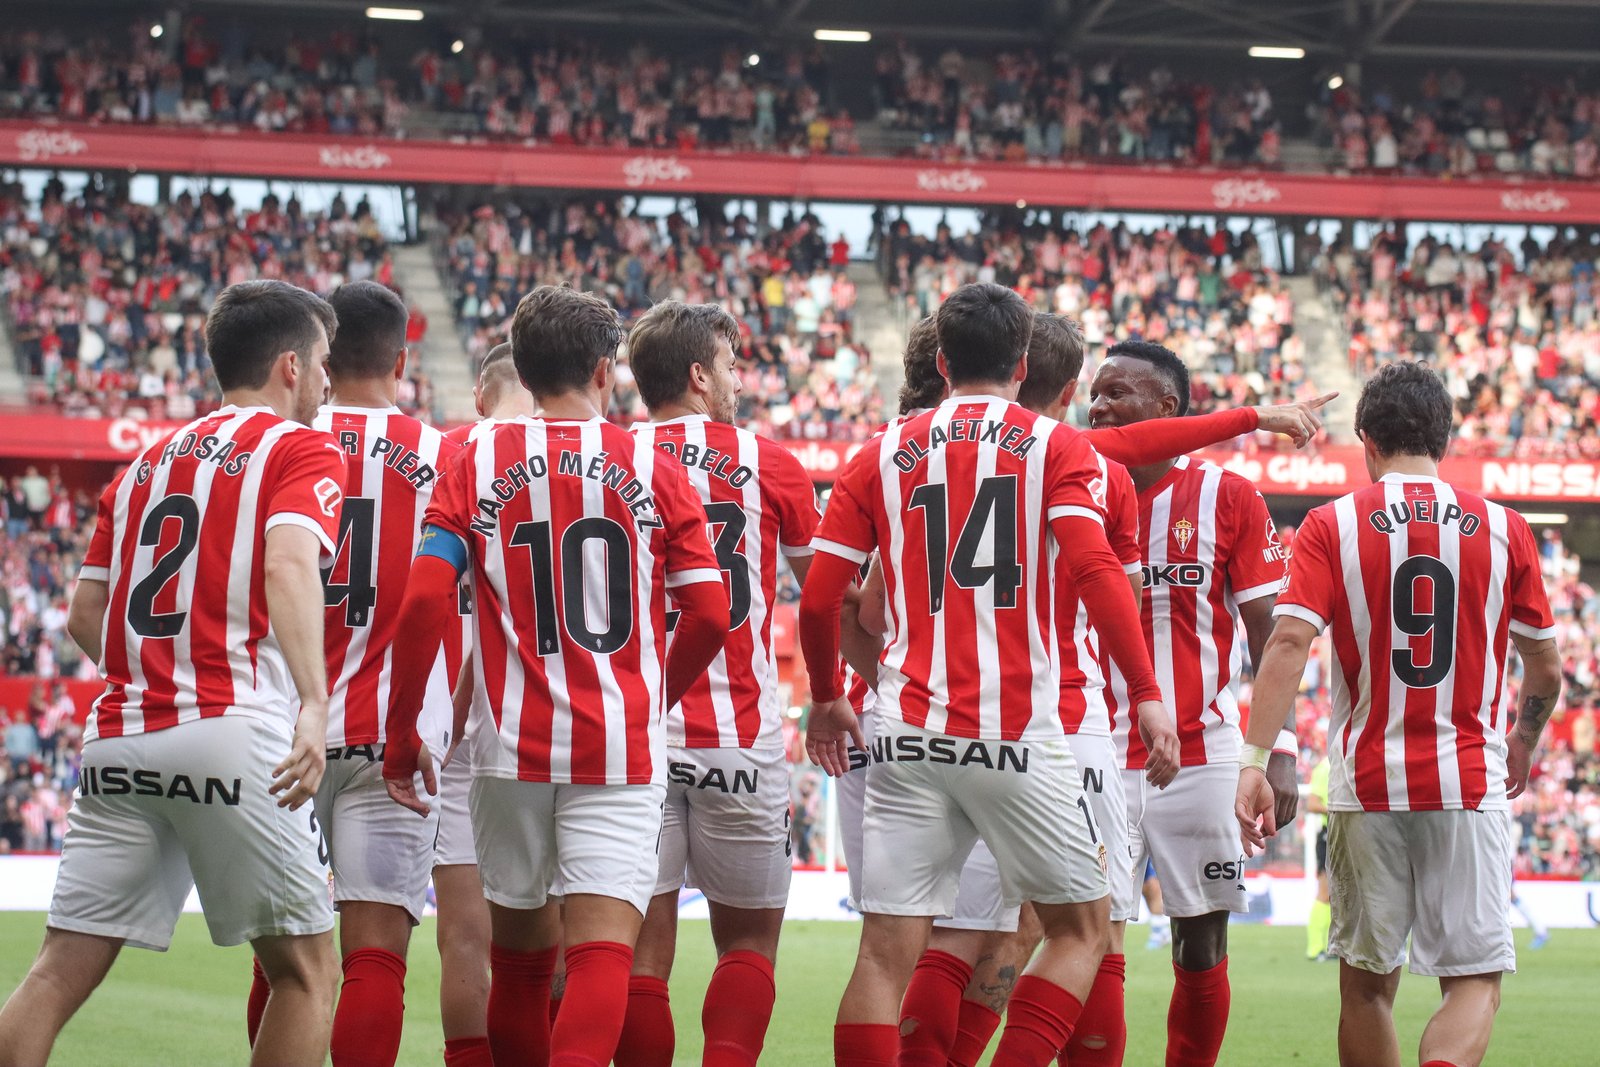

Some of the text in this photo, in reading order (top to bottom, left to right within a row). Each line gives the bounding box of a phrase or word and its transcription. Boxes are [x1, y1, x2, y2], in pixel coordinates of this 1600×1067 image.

[160, 432, 252, 476] ROSAS
[369, 436, 436, 490] PIER
[891, 418, 1038, 473] OLAETXEA
[469, 450, 664, 538] NACHO MÉNDEZ
[1482, 461, 1600, 497] NISS
[907, 473, 1022, 616] 14
[1368, 500, 1481, 537] QUEIPO
[127, 493, 200, 638] 2
[320, 496, 377, 627] 4
[508, 516, 633, 657] 10
[1391, 554, 1456, 689] 9
[667, 761, 759, 794] SAN
[871, 735, 1029, 773] NISSAN
[78, 766, 242, 806] NISSAN
